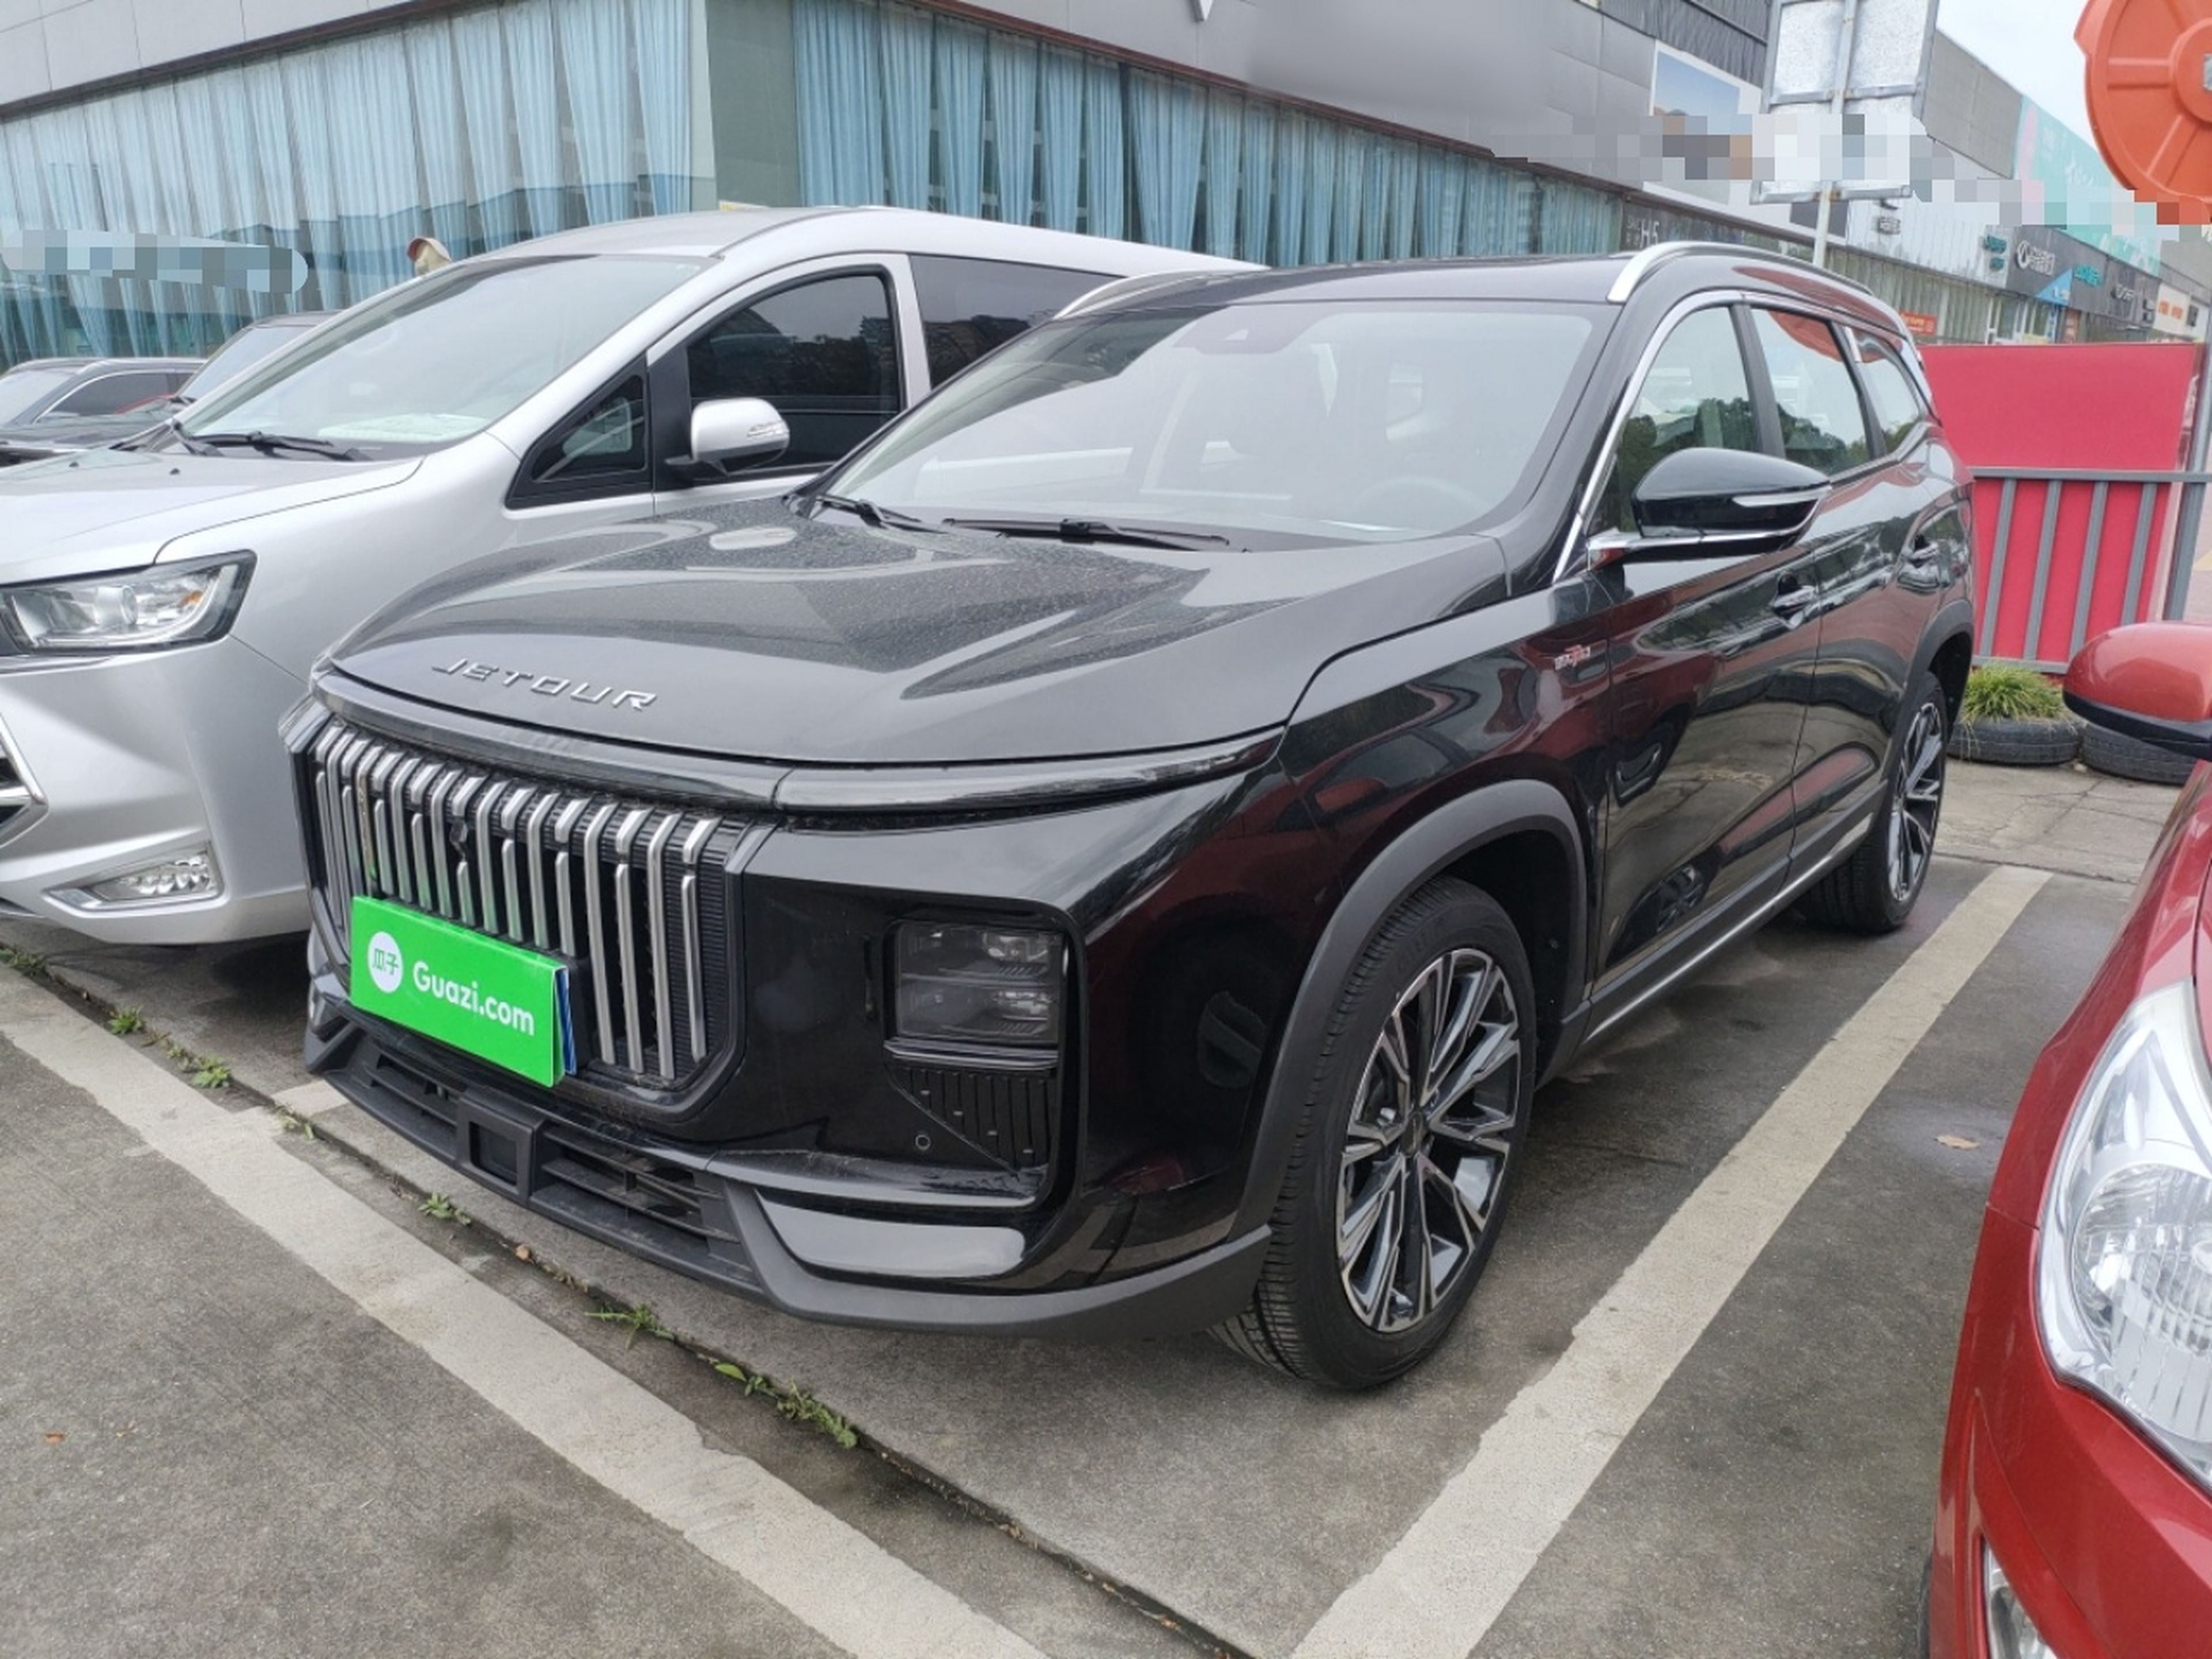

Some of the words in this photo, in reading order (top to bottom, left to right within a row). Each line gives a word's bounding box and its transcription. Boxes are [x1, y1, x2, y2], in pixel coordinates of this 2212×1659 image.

[431, 657, 658, 712] JETOUR
[373, 948, 399, 976] 瓜子
[412, 960, 535, 1036] Guazi.com
